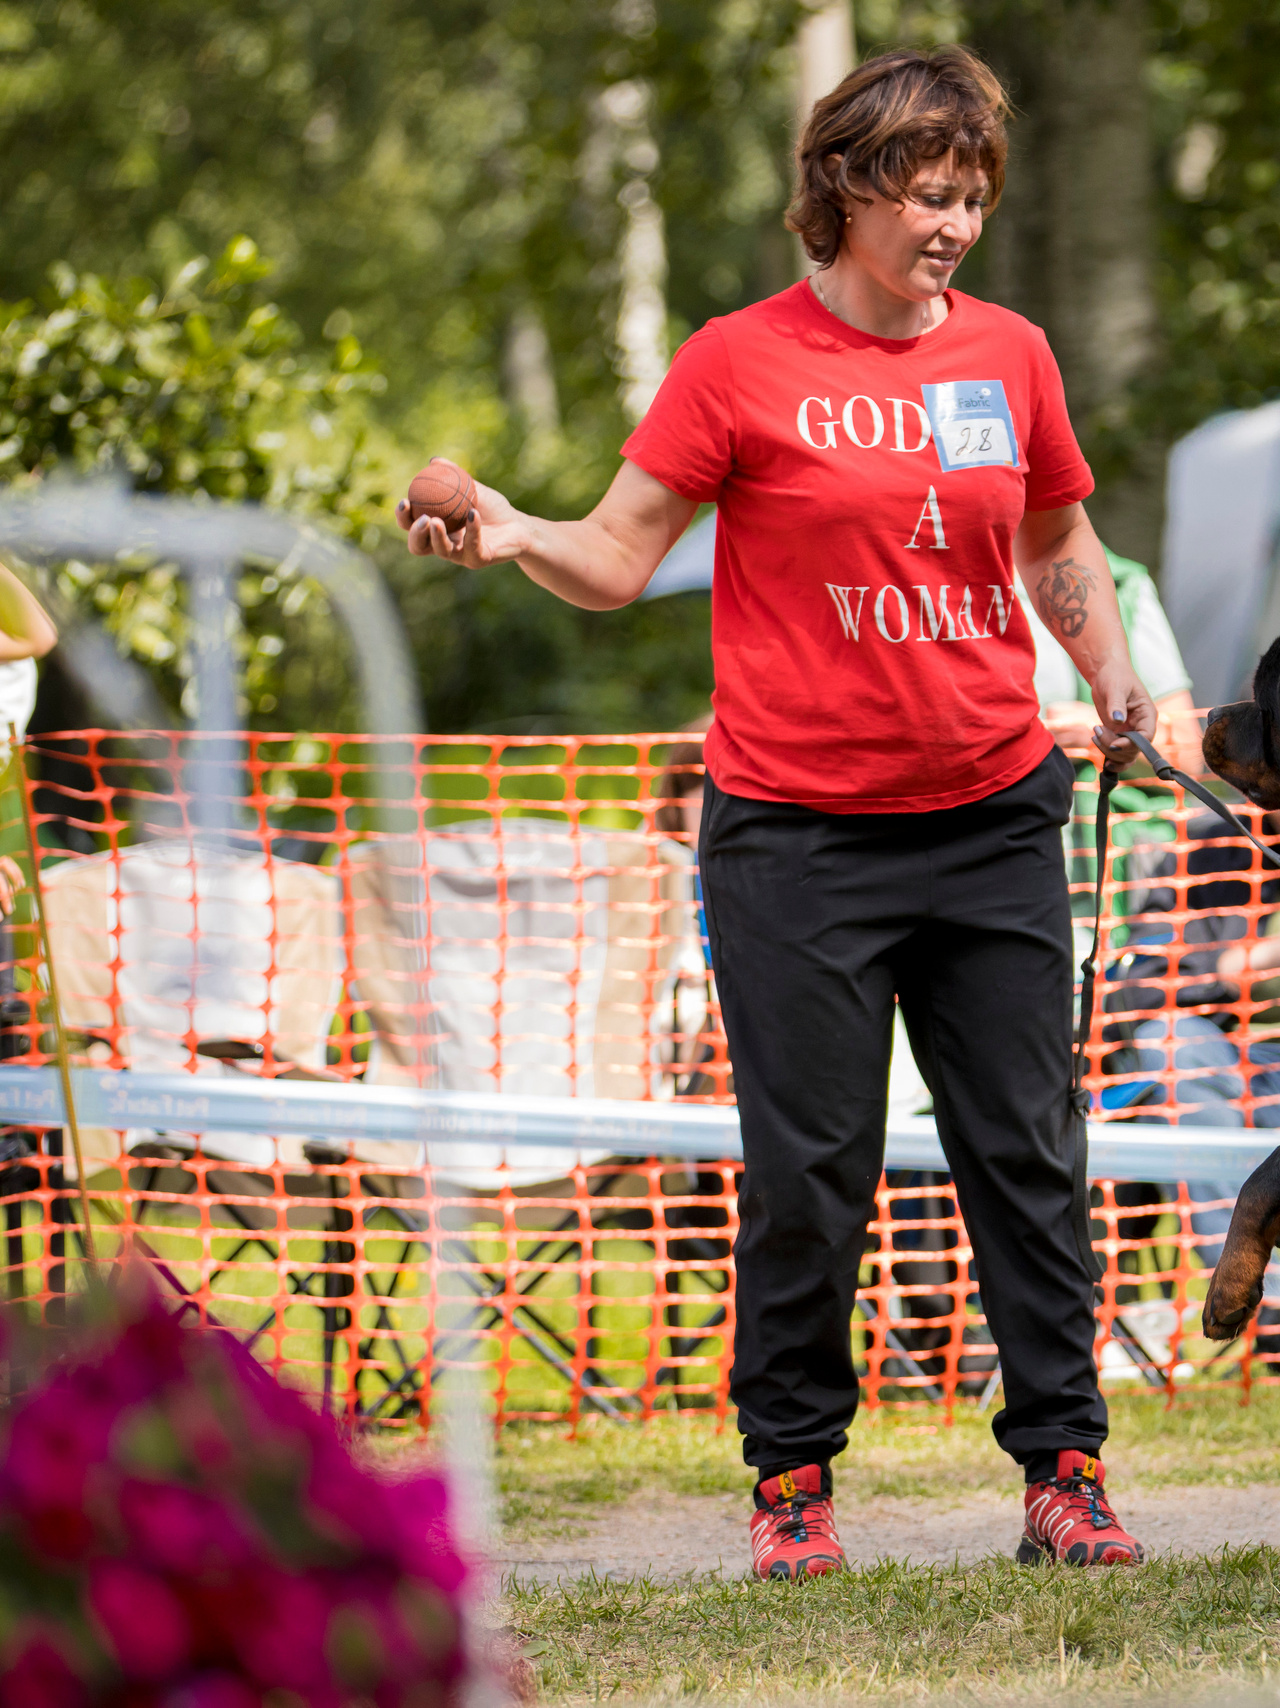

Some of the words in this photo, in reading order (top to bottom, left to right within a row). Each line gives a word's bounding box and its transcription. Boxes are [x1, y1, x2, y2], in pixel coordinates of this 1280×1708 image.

[796, 395, 932, 452] GOD
[955, 426, 992, 456] 28
[903, 485, 950, 549] A
[824, 582, 1015, 643] WOMAN
